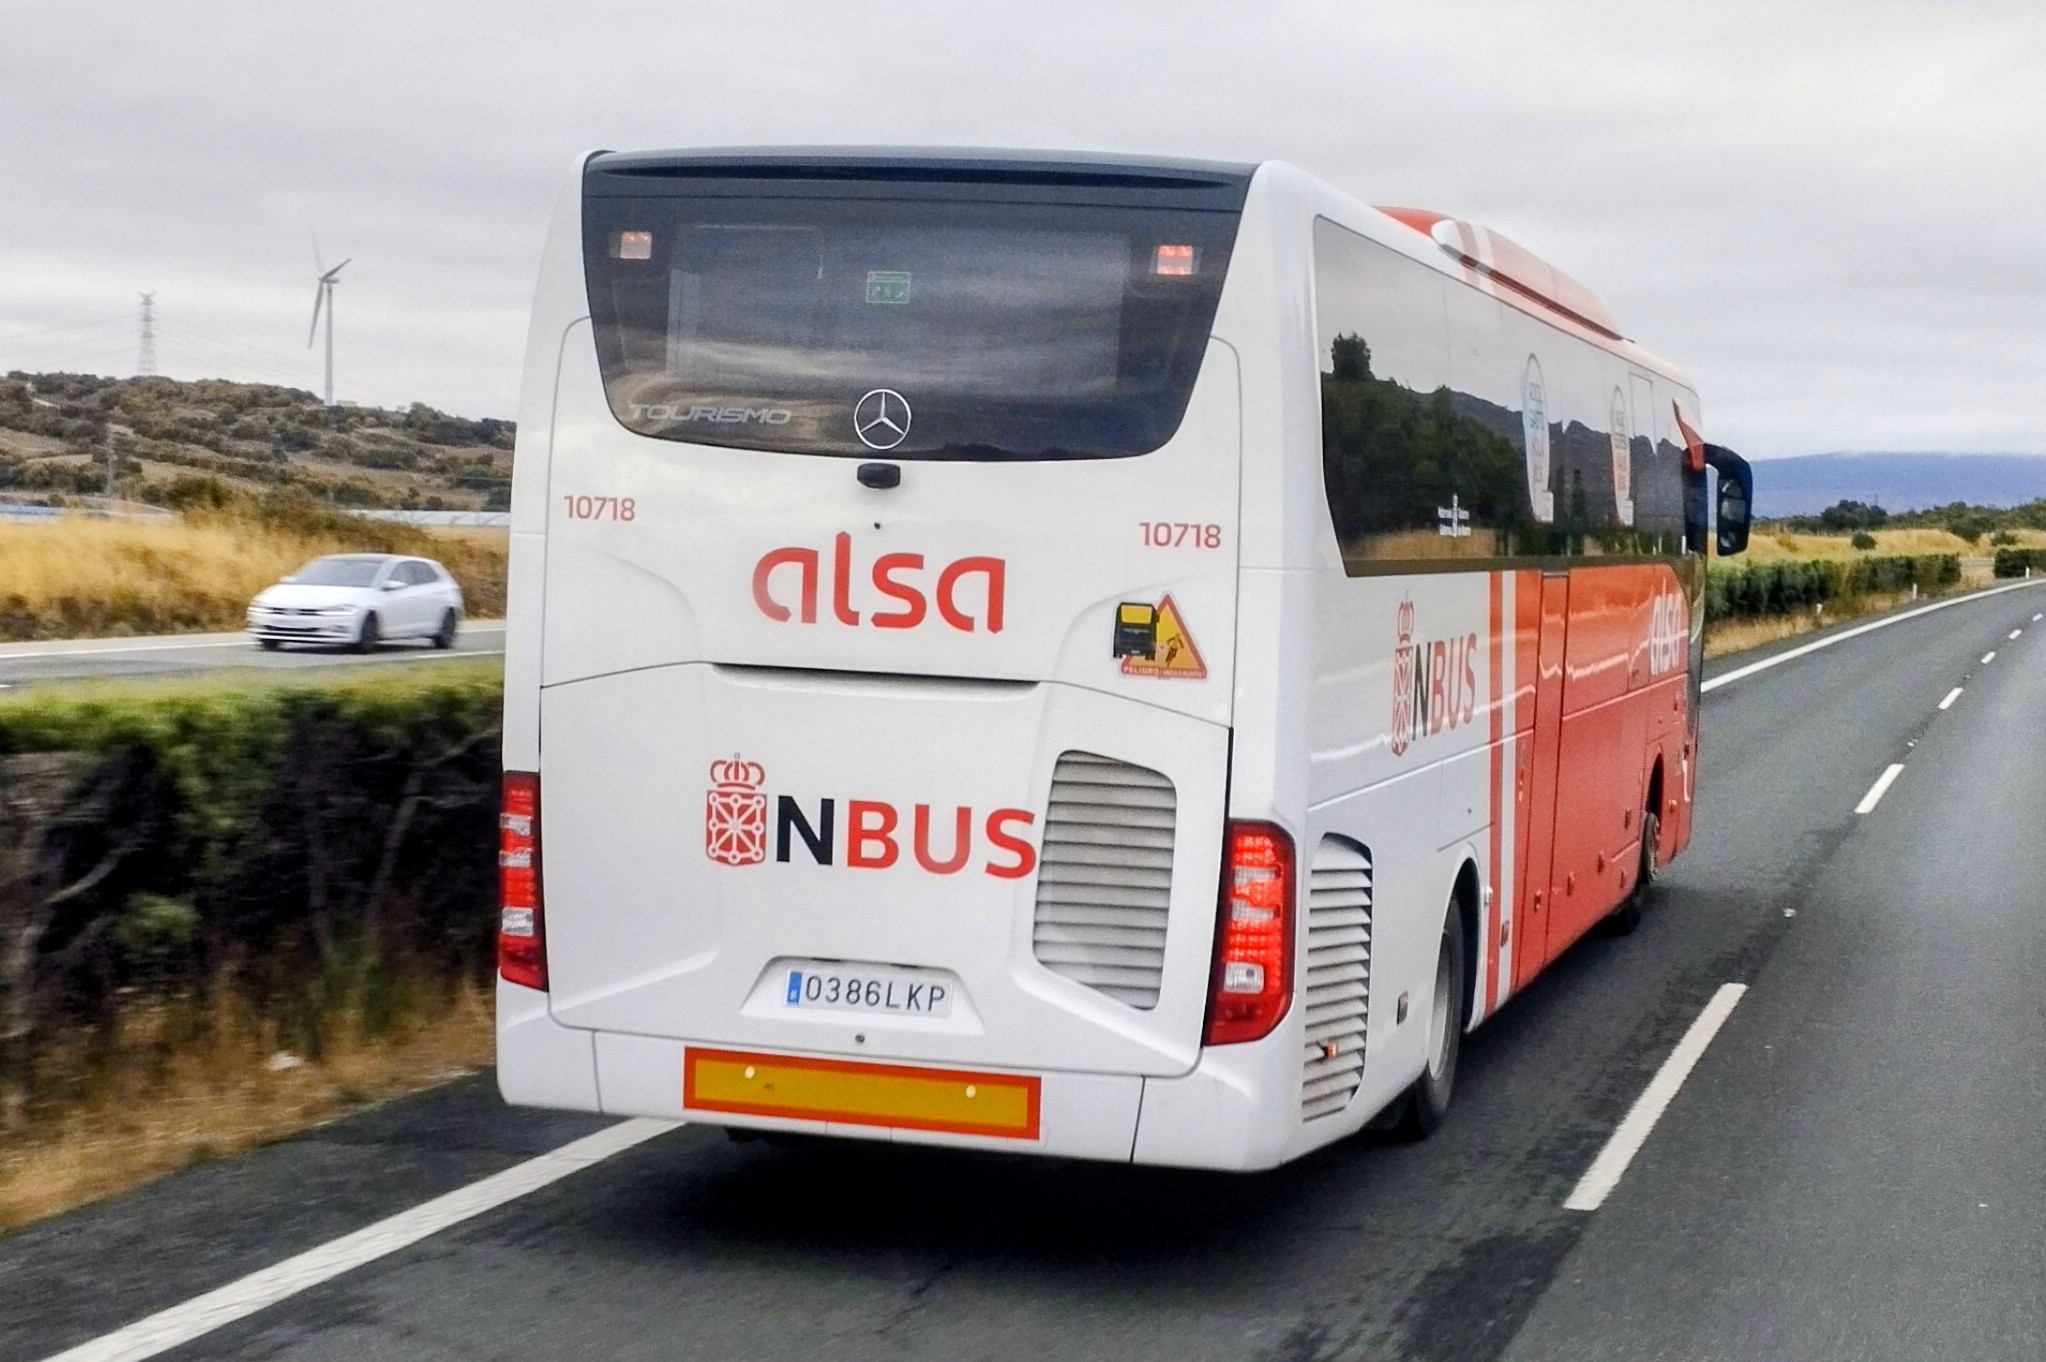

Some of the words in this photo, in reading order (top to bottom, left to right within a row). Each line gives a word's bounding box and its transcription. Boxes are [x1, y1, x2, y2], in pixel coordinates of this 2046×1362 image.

[629, 404, 792, 425] TOURISMO
[564, 495, 635, 522] 10718
[1139, 522, 1221, 549] 10718
[752, 531, 1006, 634] alsa
[1412, 632, 1476, 742] NBUS
[775, 794, 1037, 879] NBUS
[806, 975, 946, 1012] 0386LKP
